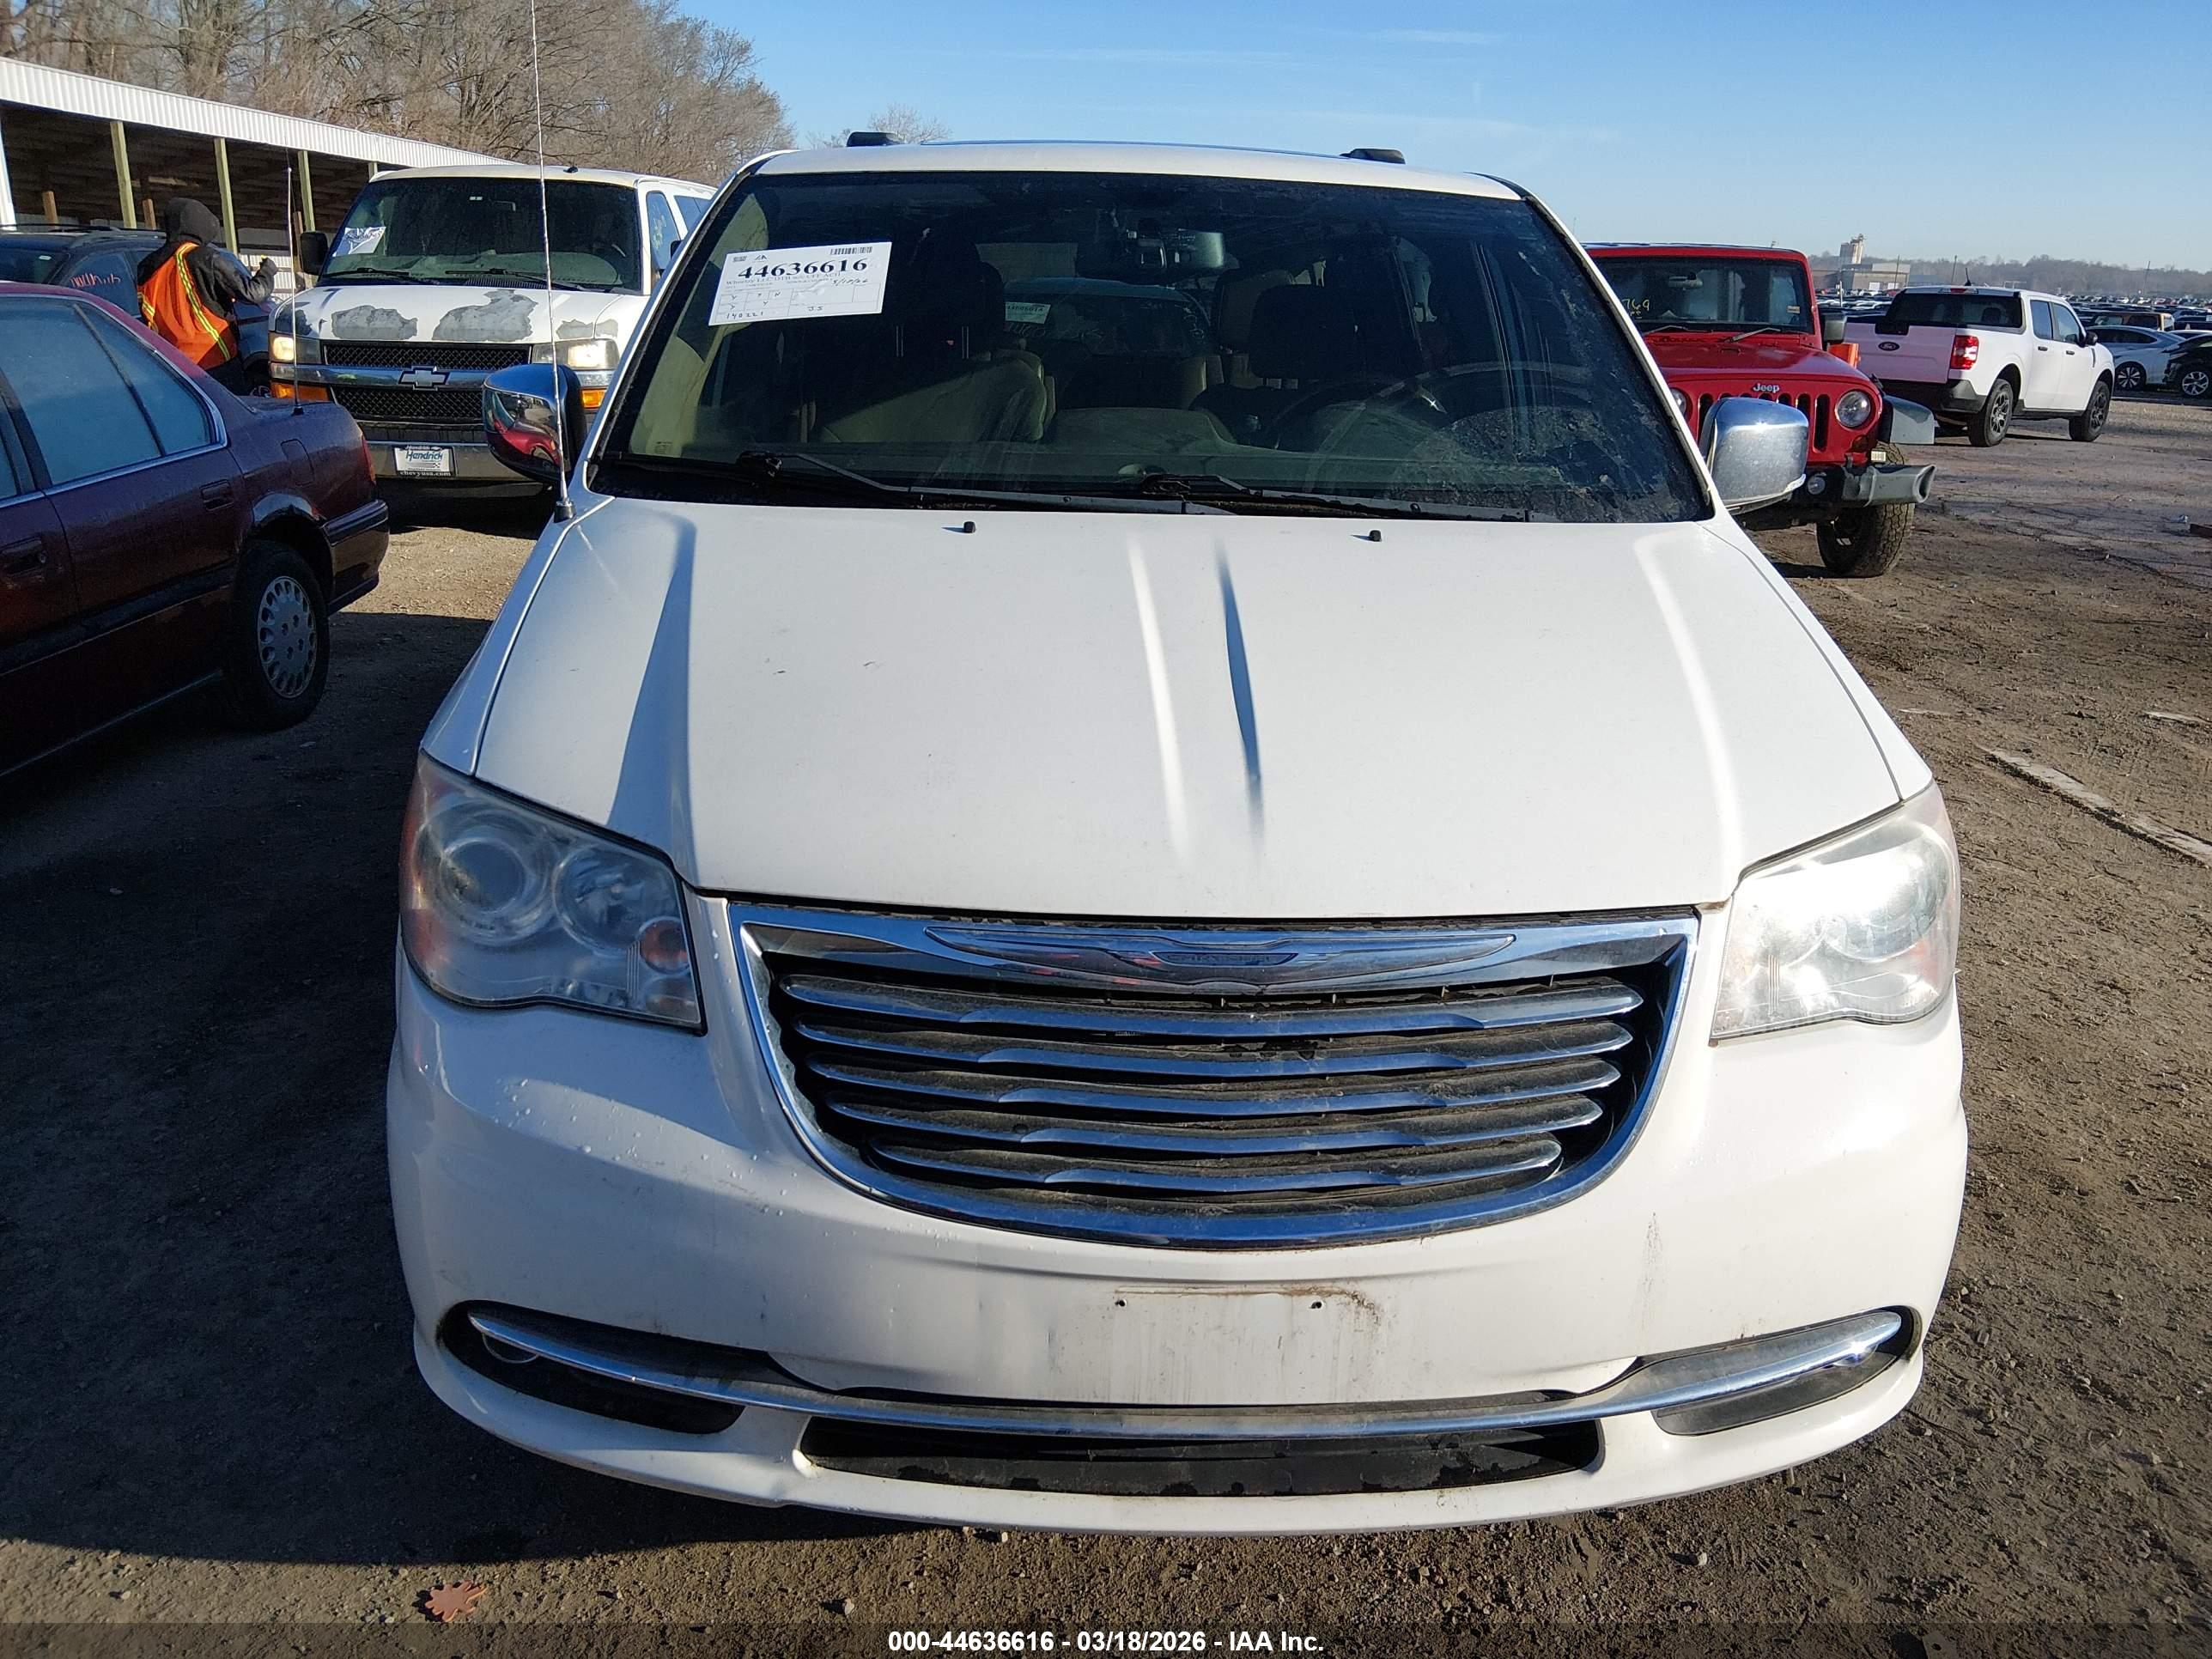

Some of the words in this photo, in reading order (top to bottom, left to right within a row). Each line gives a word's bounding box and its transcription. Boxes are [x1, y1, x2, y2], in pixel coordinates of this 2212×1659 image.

[738, 258, 868, 279] 44636616
[1753, 383, 1780, 393] Jeep
[405, 451, 443, 461] Hendrick
